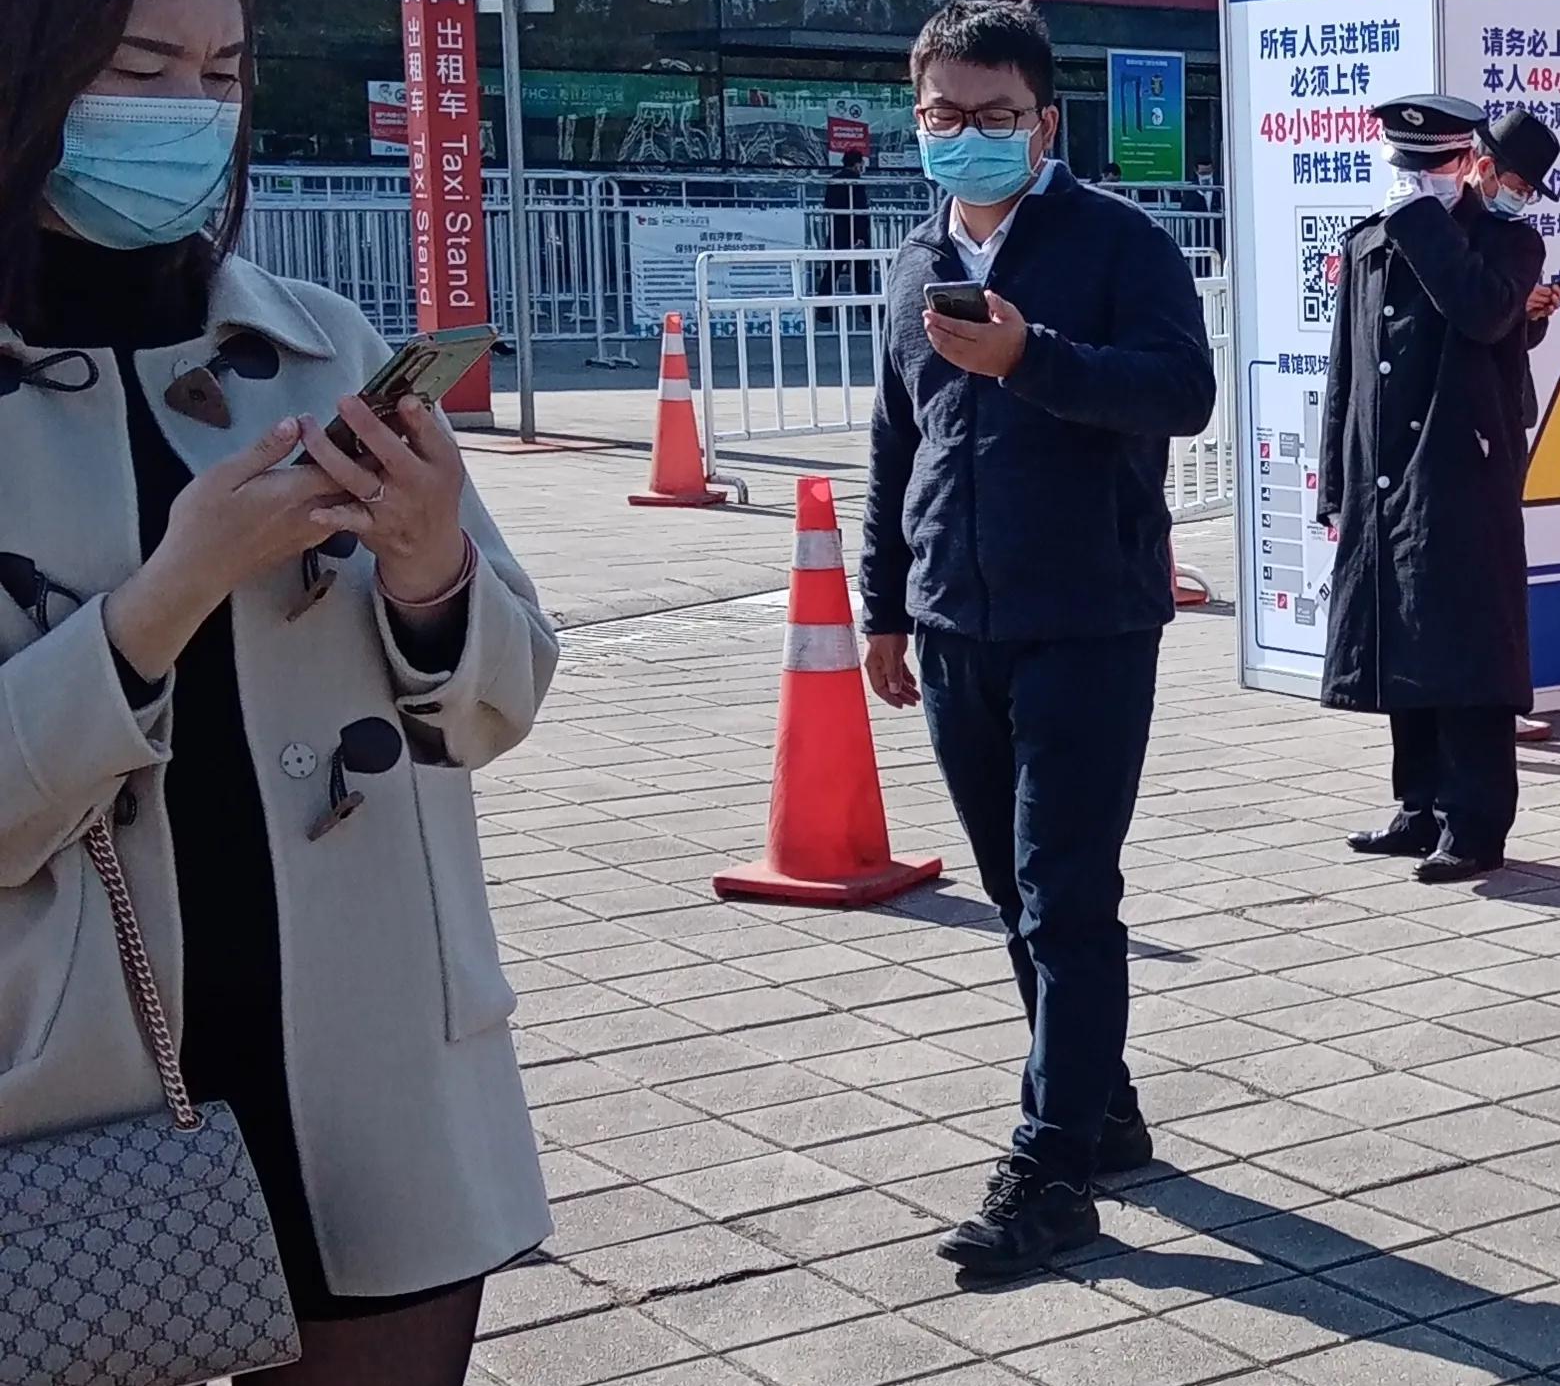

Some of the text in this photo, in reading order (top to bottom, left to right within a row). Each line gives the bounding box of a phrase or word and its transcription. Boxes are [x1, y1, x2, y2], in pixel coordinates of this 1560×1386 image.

[408, 16, 425, 118] 出租车
[436, 18, 468, 120] 出租车
[1260, 18, 1401, 60] 所有人员进馆前
[1290, 63, 1371, 97] 必须上传
[1260, 104, 1381, 145] 48小时内核
[1293, 150, 1373, 185] 阴性报告
[413, 132, 432, 306] Taxi Stand
[441, 134, 475, 307] Taxi Stand
